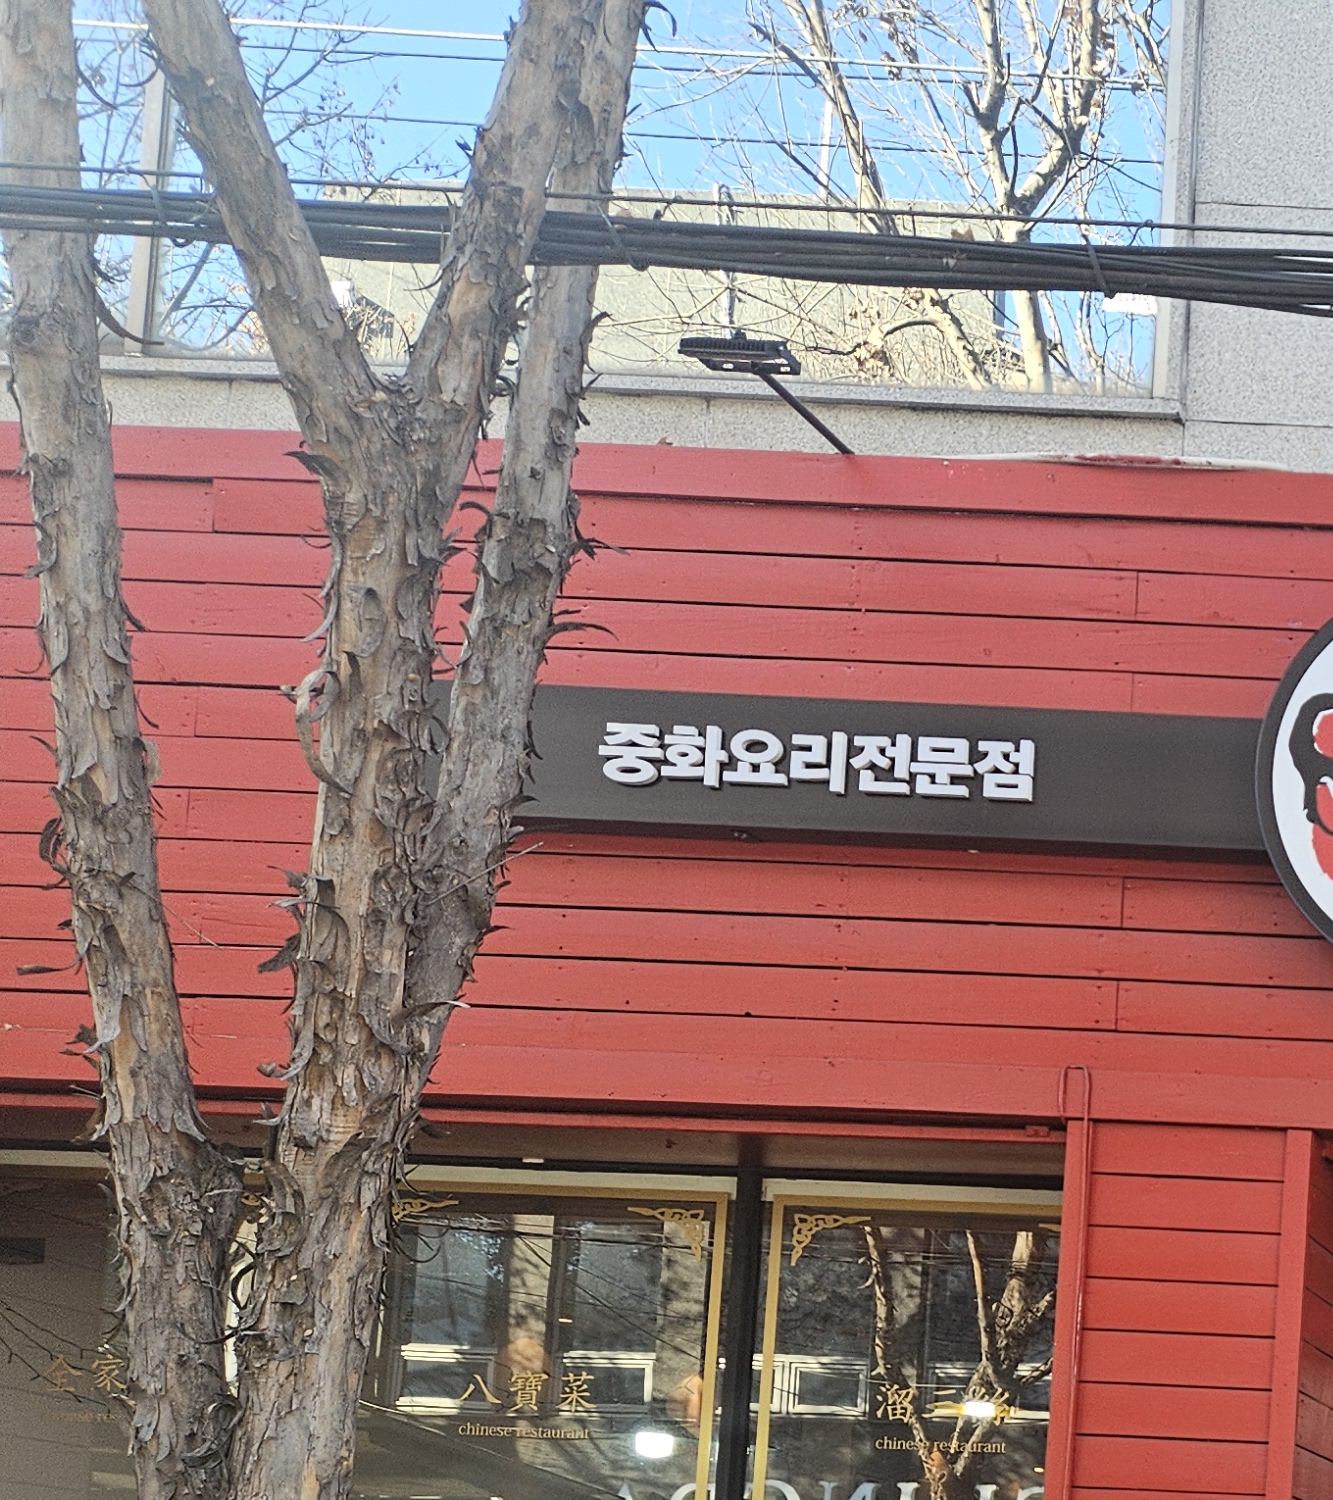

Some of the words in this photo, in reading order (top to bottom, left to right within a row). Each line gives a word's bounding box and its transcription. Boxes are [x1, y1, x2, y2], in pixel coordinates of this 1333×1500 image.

[600, 722, 1036, 802] 중화요리전문점
[458, 1422, 512, 1437] chinese
[517, 1425, 589, 1439] restaurant
[875, 1436, 929, 1451] chinese
[934, 1440, 1007, 1455] restaurant
